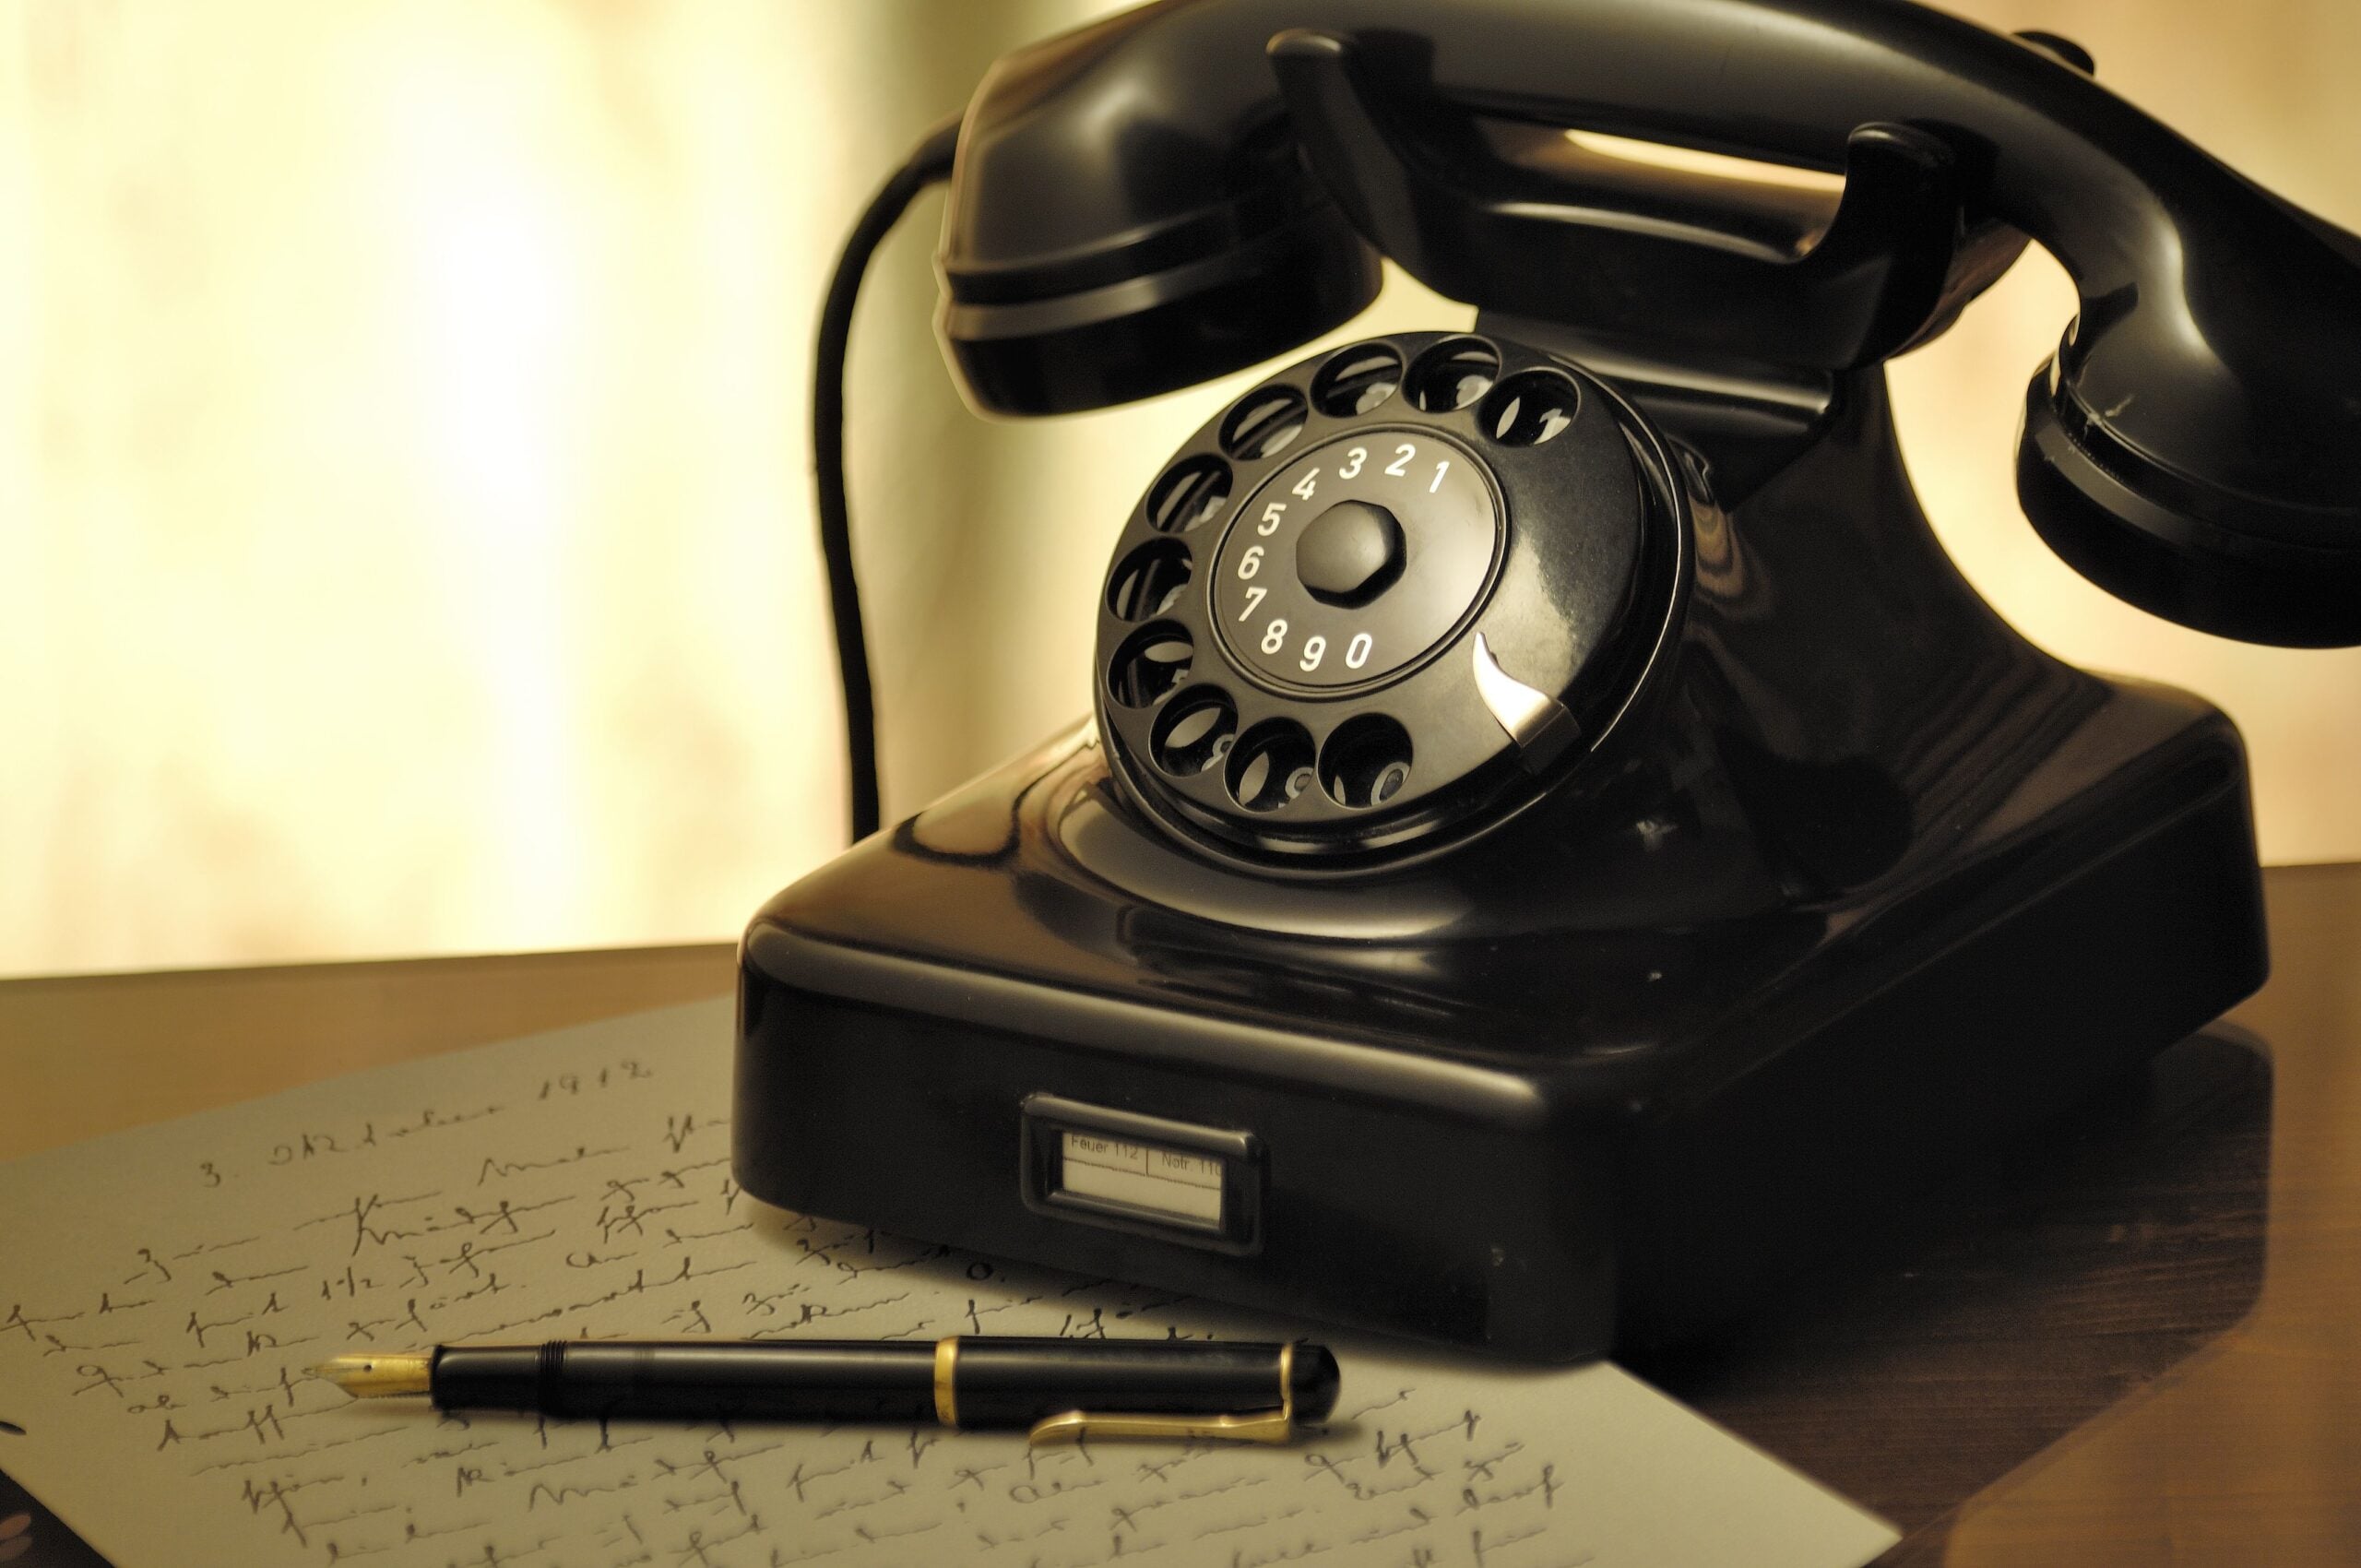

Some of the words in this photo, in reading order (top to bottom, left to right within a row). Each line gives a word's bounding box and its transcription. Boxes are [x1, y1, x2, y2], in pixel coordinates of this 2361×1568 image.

[1339, 447, 1367, 479] 3
[1384, 444, 1416, 477] 2
[1429, 461, 1450, 493] 1
[1292, 468, 1320, 500] 4
[1257, 503, 1287, 536] 5
[1237, 546, 1264, 579] 6
[1238, 587, 1267, 622] 7
[1261, 619, 1287, 654] 8
[1346, 633, 1372, 669] 0
[1299, 636, 1326, 671] 9
[1071, 1134, 1109, 1154] Feuer
